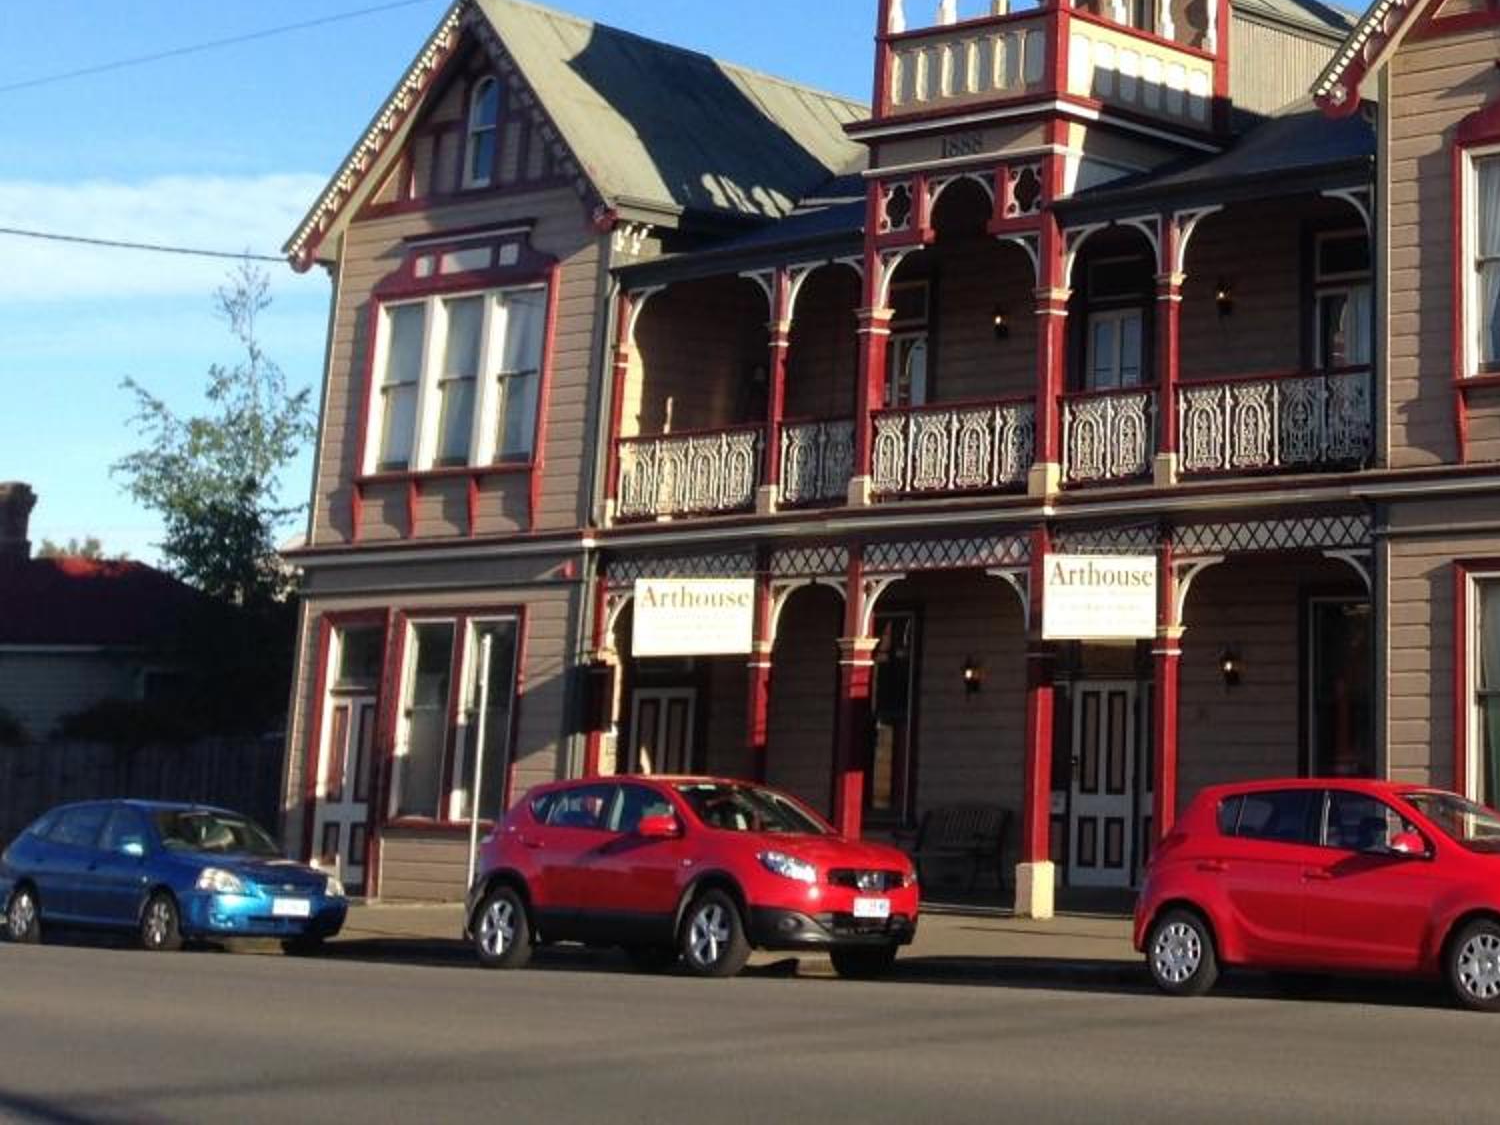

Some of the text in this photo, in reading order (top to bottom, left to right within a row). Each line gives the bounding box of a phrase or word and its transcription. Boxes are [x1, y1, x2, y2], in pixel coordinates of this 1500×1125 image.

[942, 133, 983, 158] 1888
[1049, 560, 1153, 587] Arthouse
[640, 584, 750, 608] Arthouse
